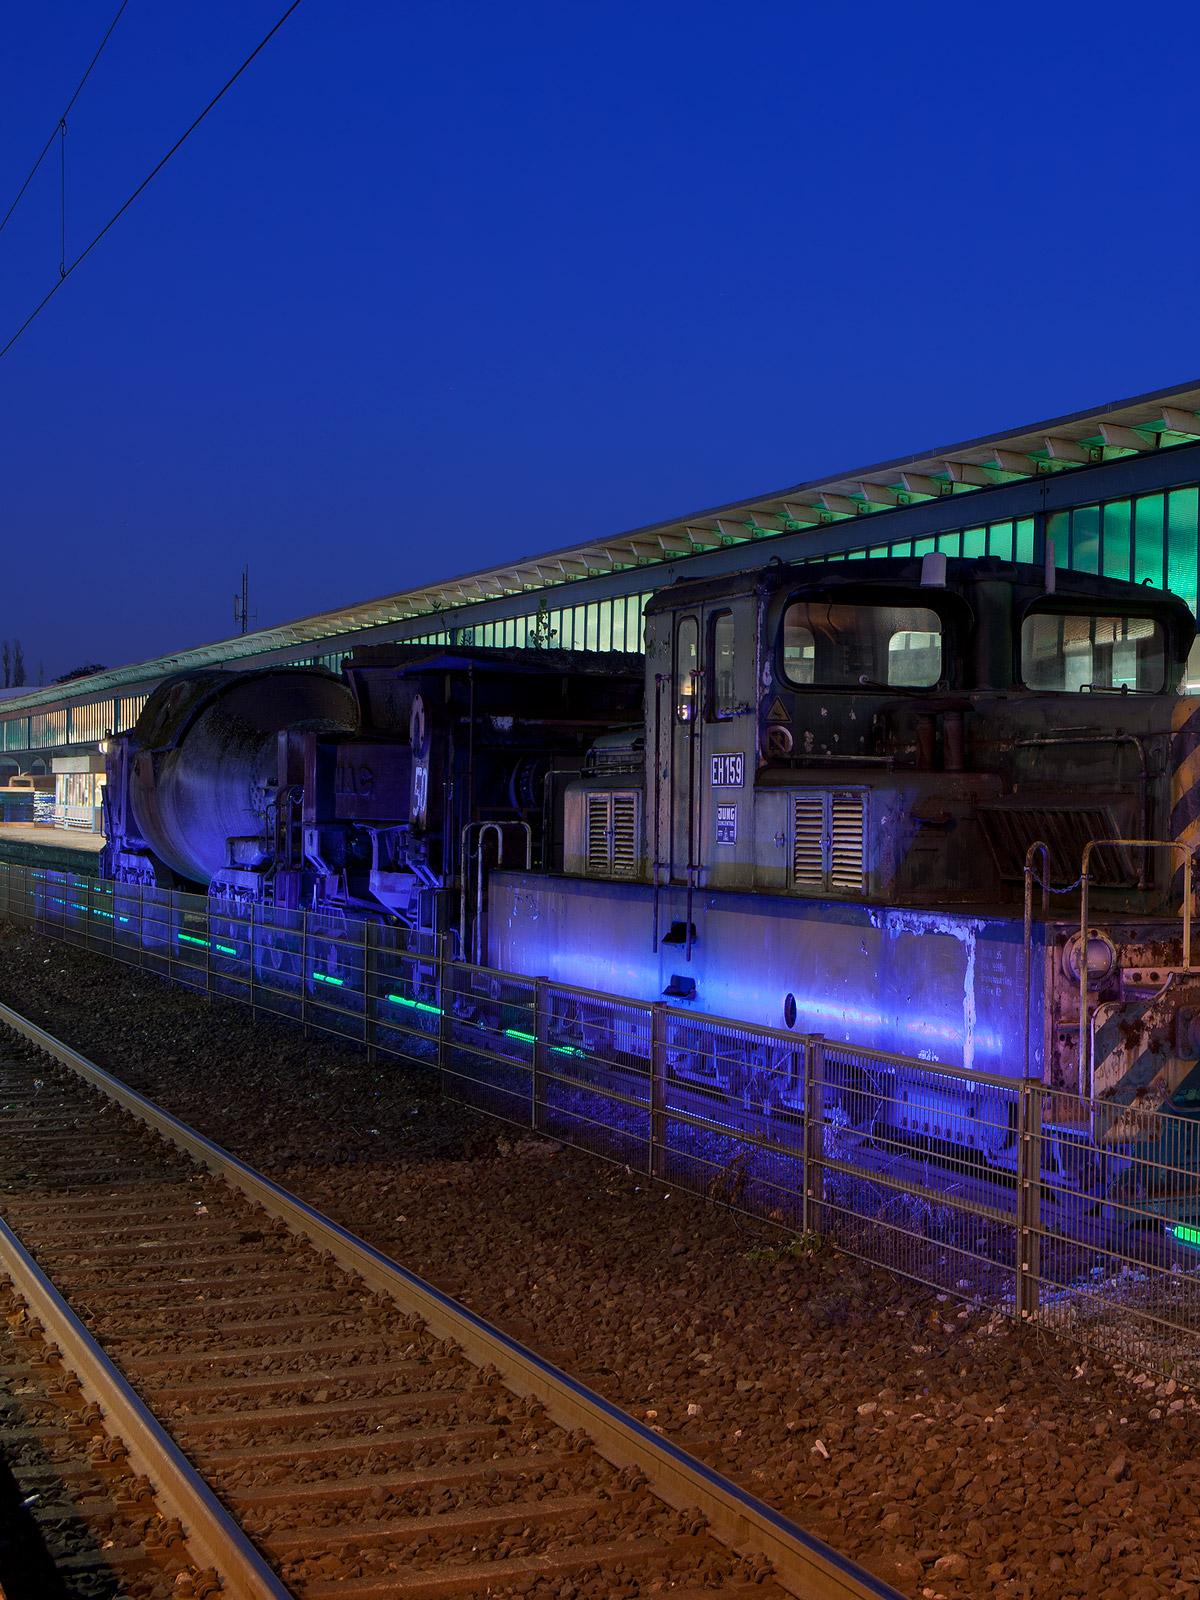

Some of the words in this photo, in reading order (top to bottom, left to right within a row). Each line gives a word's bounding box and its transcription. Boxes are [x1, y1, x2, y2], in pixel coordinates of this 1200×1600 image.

[712, 757, 724, 784] EH
[725, 756, 742, 784] 159
[717, 807, 735, 820] JUNG
